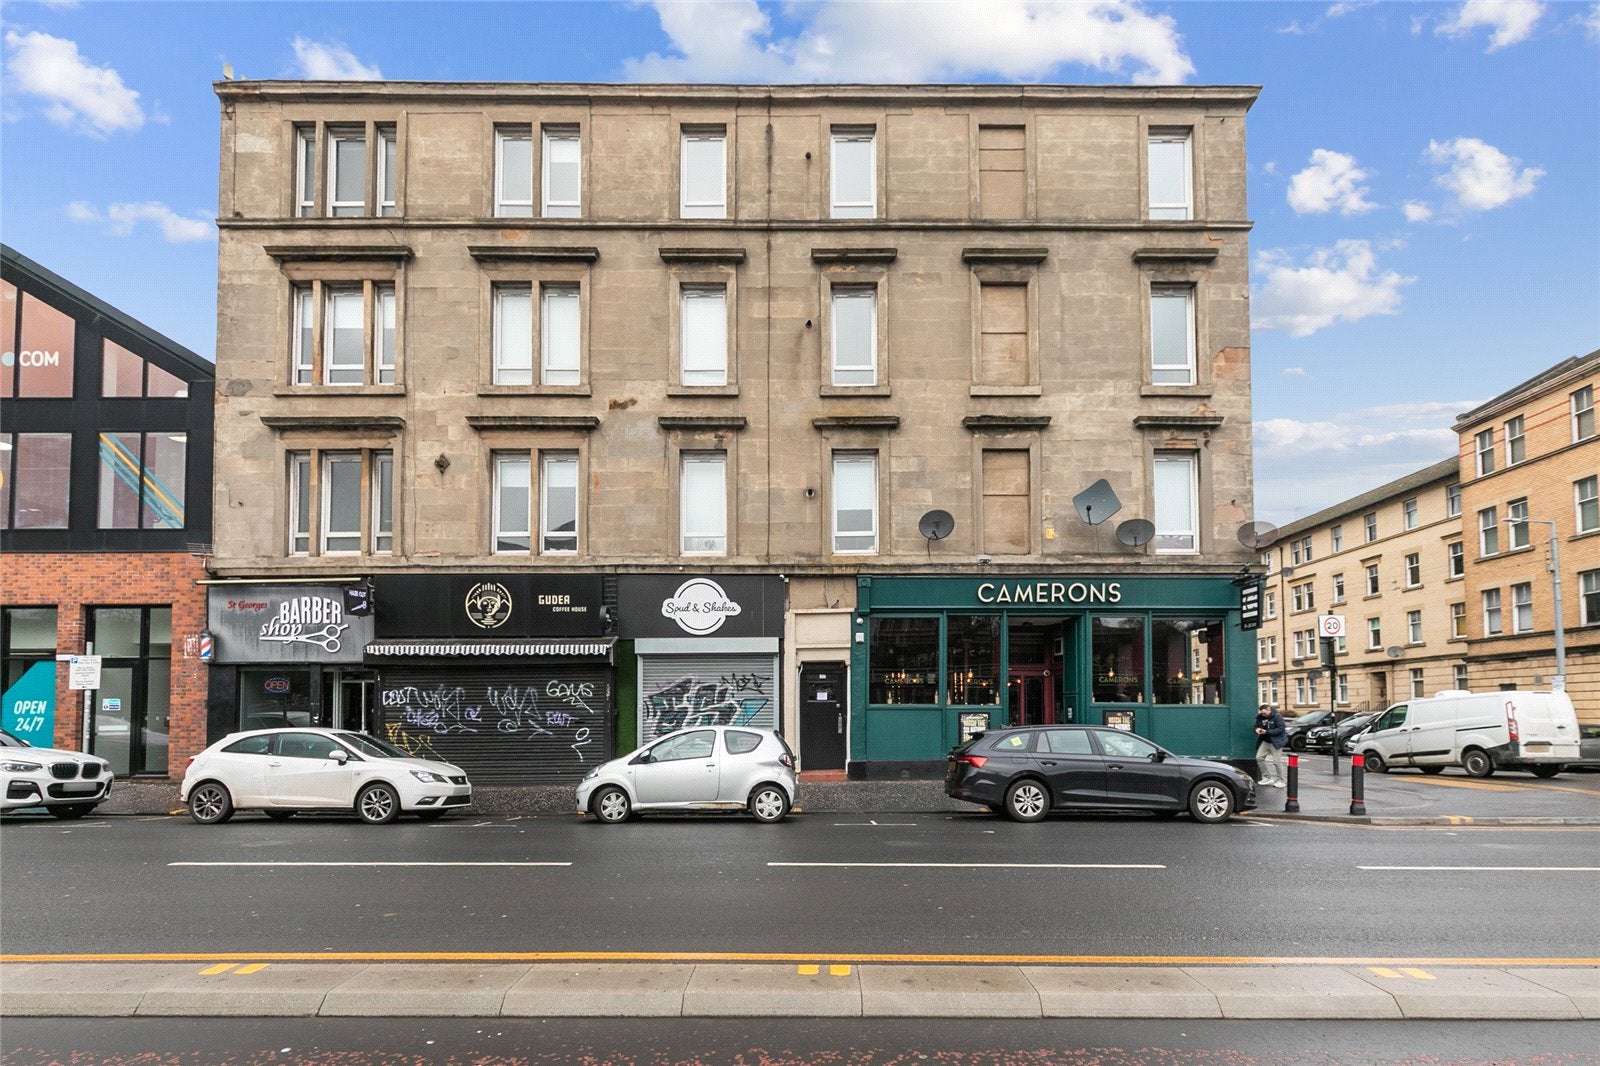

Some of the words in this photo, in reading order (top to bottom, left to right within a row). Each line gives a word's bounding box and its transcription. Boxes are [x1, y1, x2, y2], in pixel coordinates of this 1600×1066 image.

[978, 582, 1121, 603] CAMERONS
[538, 594, 570, 605] GUDEA
[238, 601, 268, 613] Georges
[280, 596, 342, 624] BARBER
[665, 602, 691, 614] Spud
[692, 603, 699, 613] &
[702, 602, 737, 613] Shakes
[260, 616, 302, 644] shop
[1327, 621, 1338, 630] 20
[264, 680, 289, 690] OPEN
[13, 700, 47, 715] OPEN
[15, 716, 45, 732] 24/7
